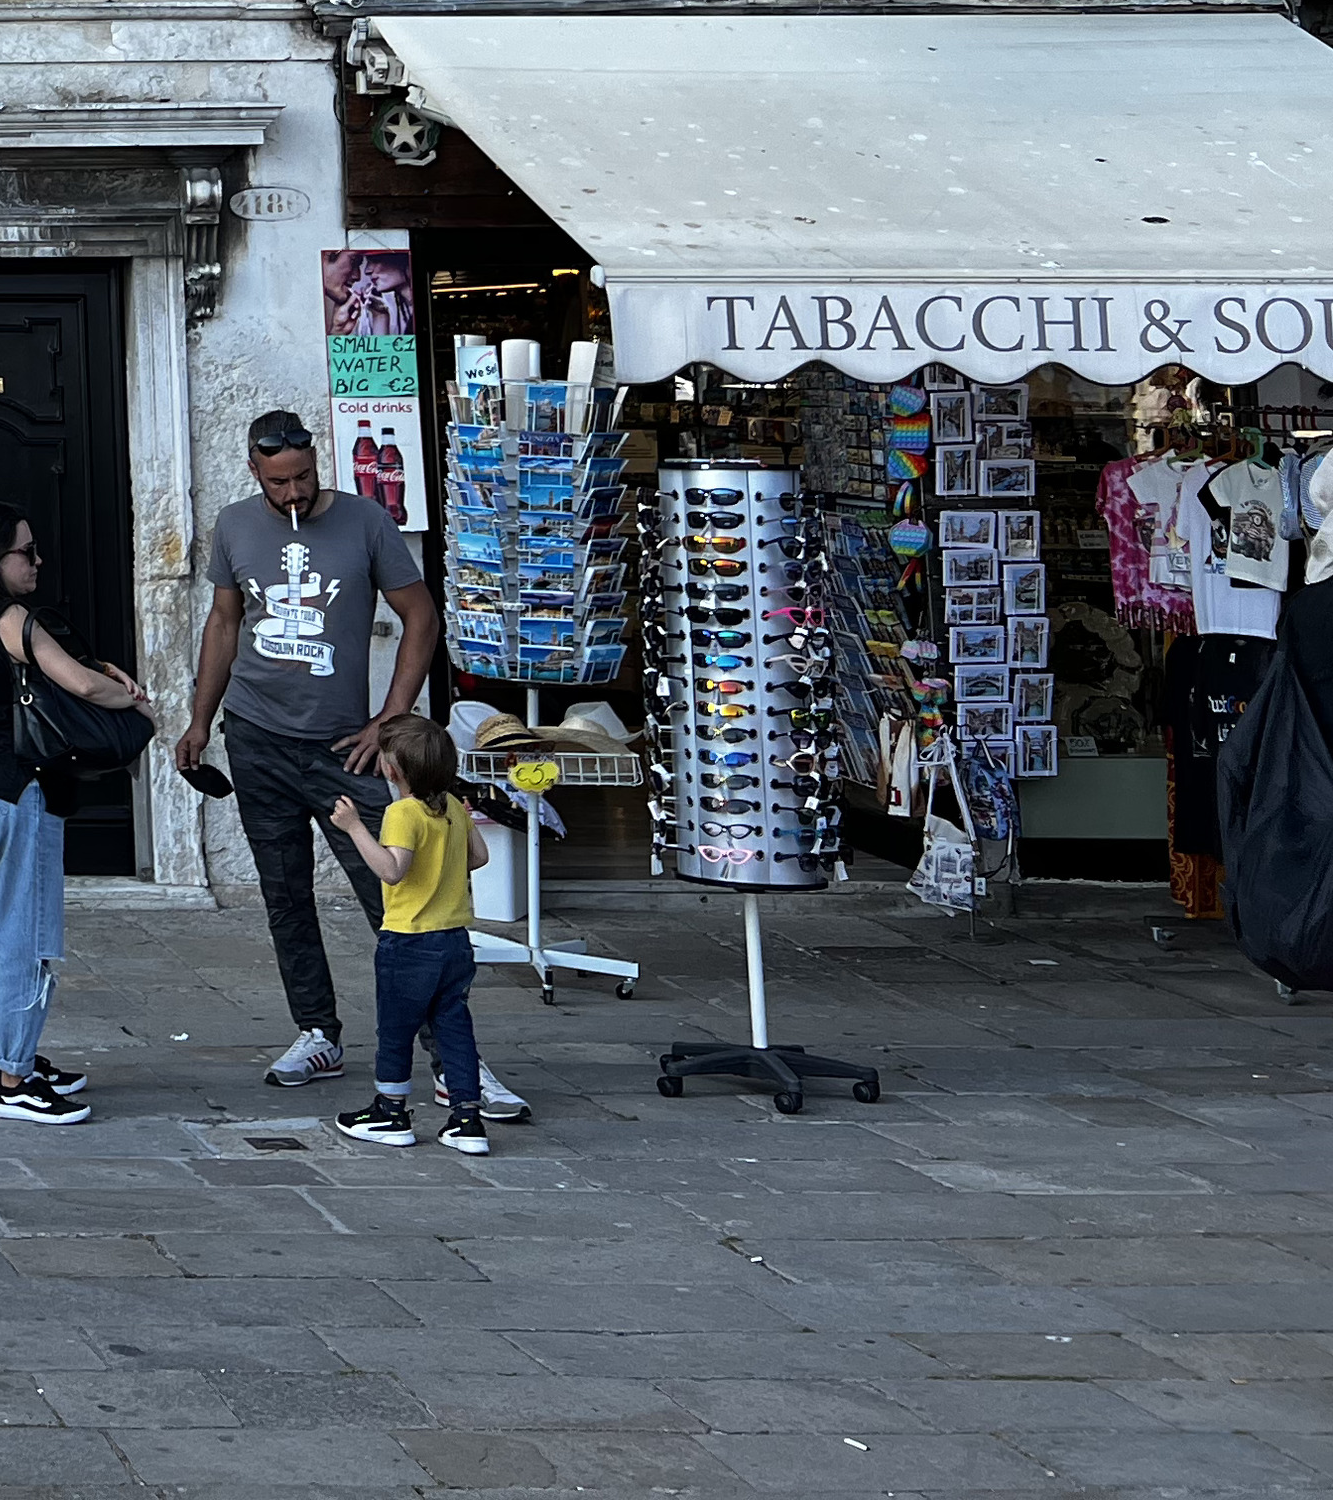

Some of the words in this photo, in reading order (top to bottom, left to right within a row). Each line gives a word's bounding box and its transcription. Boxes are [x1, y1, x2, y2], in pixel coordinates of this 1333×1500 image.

[706, 294, 1117, 352] TABACCHI
[1139, 298, 1196, 353] &
[332, 336, 381, 354] SMALL
[333, 355, 403, 374] WATER
[338, 402, 369, 414] Cold
[372, 402, 413, 414] drinks
[296, 644, 325, 659] ROCK
